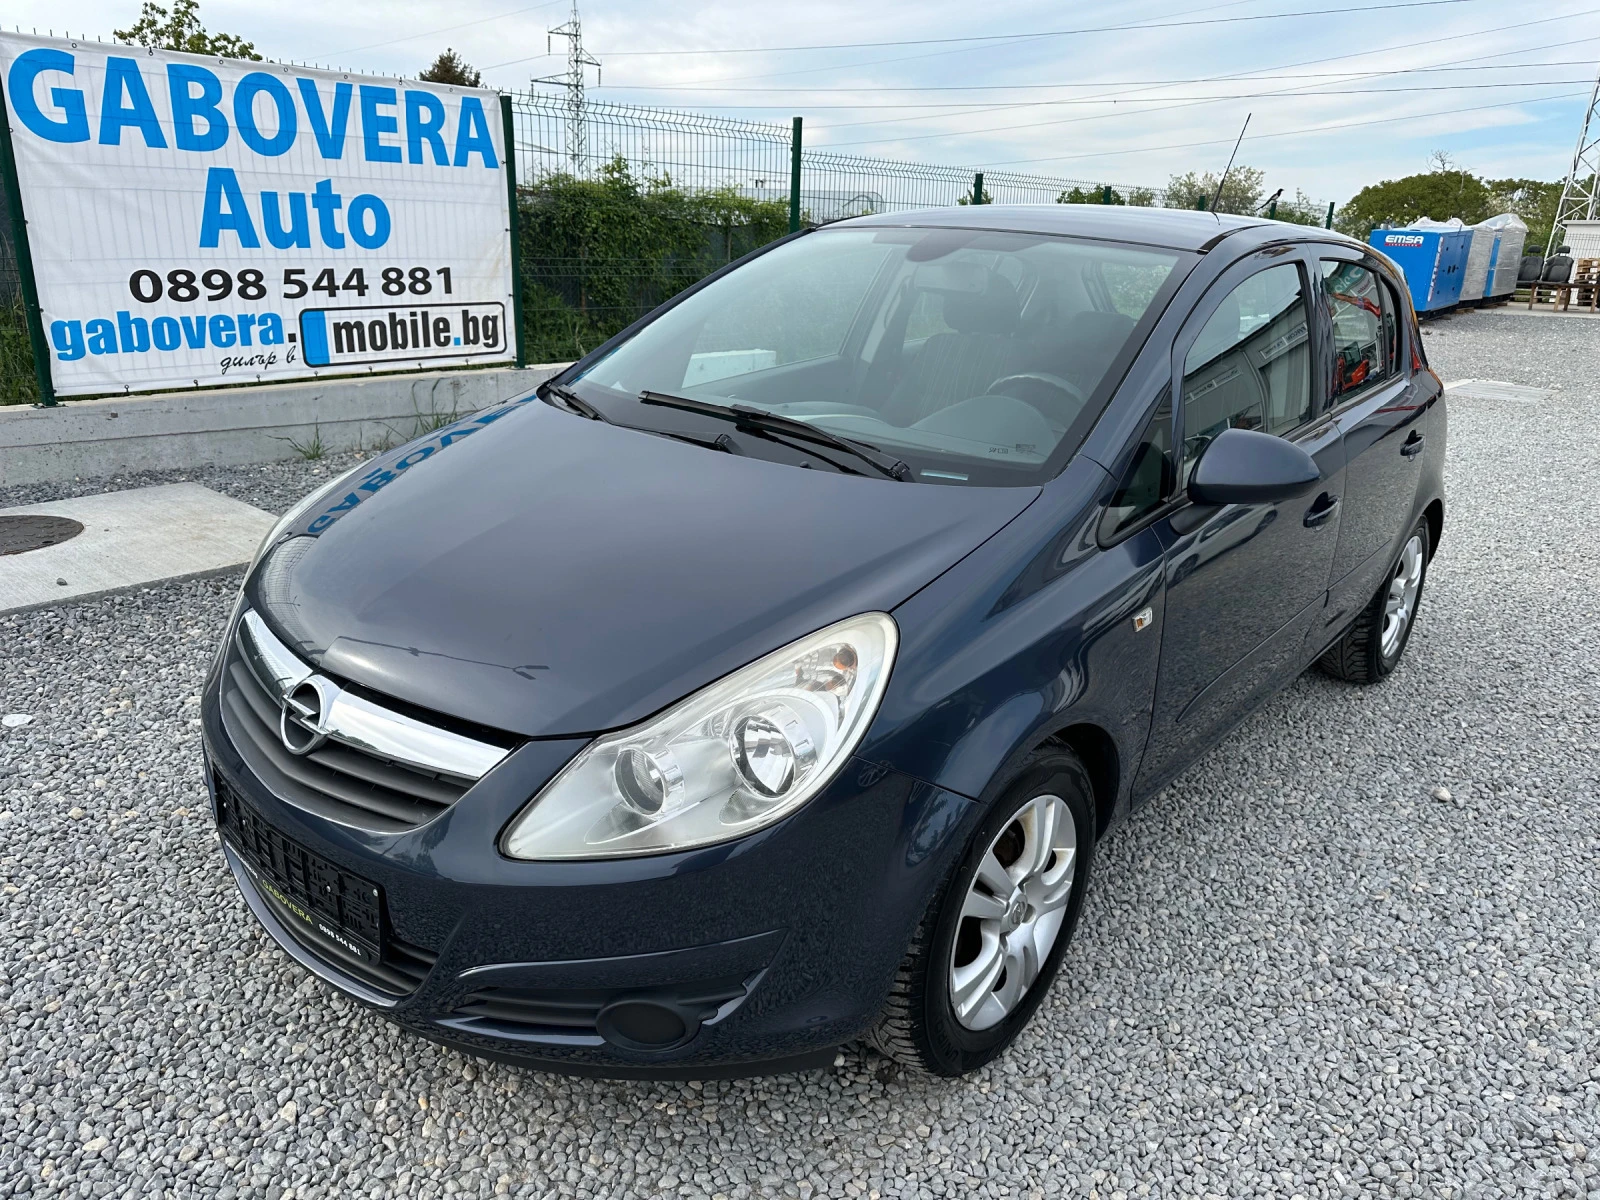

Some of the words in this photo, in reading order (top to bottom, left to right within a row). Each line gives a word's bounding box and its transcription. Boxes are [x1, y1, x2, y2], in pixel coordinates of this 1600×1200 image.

[7, 47, 500, 170] GABOVERA
[199, 167, 391, 251] Auto
[1385, 234, 1424, 244] EMSA
[129, 268, 267, 304] 0898
[283, 267, 369, 300] 544
[381, 266, 452, 296] 881
[333, 309, 499, 353] mobile.bg
[262, 879, 313, 925] GABOVERA
